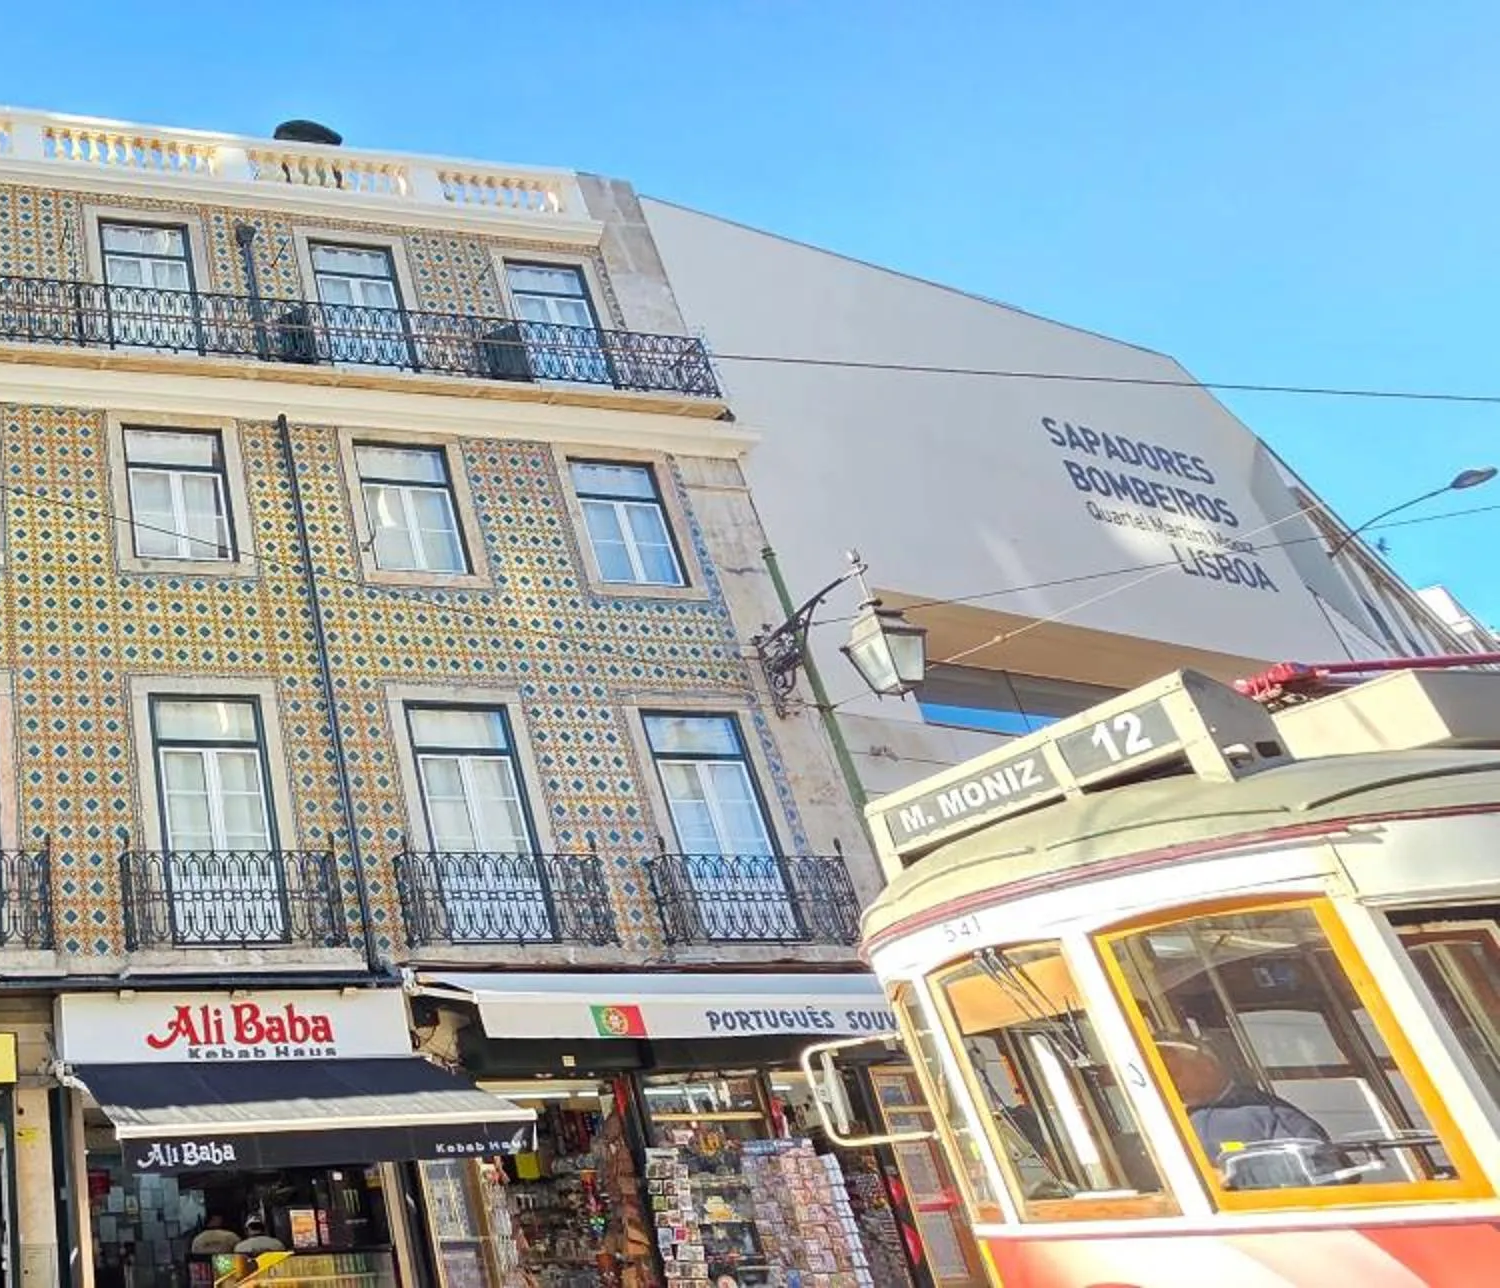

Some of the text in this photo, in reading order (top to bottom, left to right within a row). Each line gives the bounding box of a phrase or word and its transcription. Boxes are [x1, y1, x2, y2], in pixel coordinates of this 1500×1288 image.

[1041, 417, 1215, 485] SAPADORES
[1063, 460, 1239, 528] BOMBEIROS
[1086, 501, 1150, 531] Quartel
[1169, 543, 1280, 593] LISBOA
[1091, 711, 1153, 762] 12
[899, 758, 1044, 832] M. MONIZ
[943, 914, 982, 943] 541
[147, 1003, 335, 1049] Ali Baba
[706, 1006, 835, 1031] PORTUGUÊS
[188, 1046, 337, 1059] Kebab Haus
[137, 1141, 237, 1169] Ali Baba
[435, 1141, 485, 1153] Kebab
